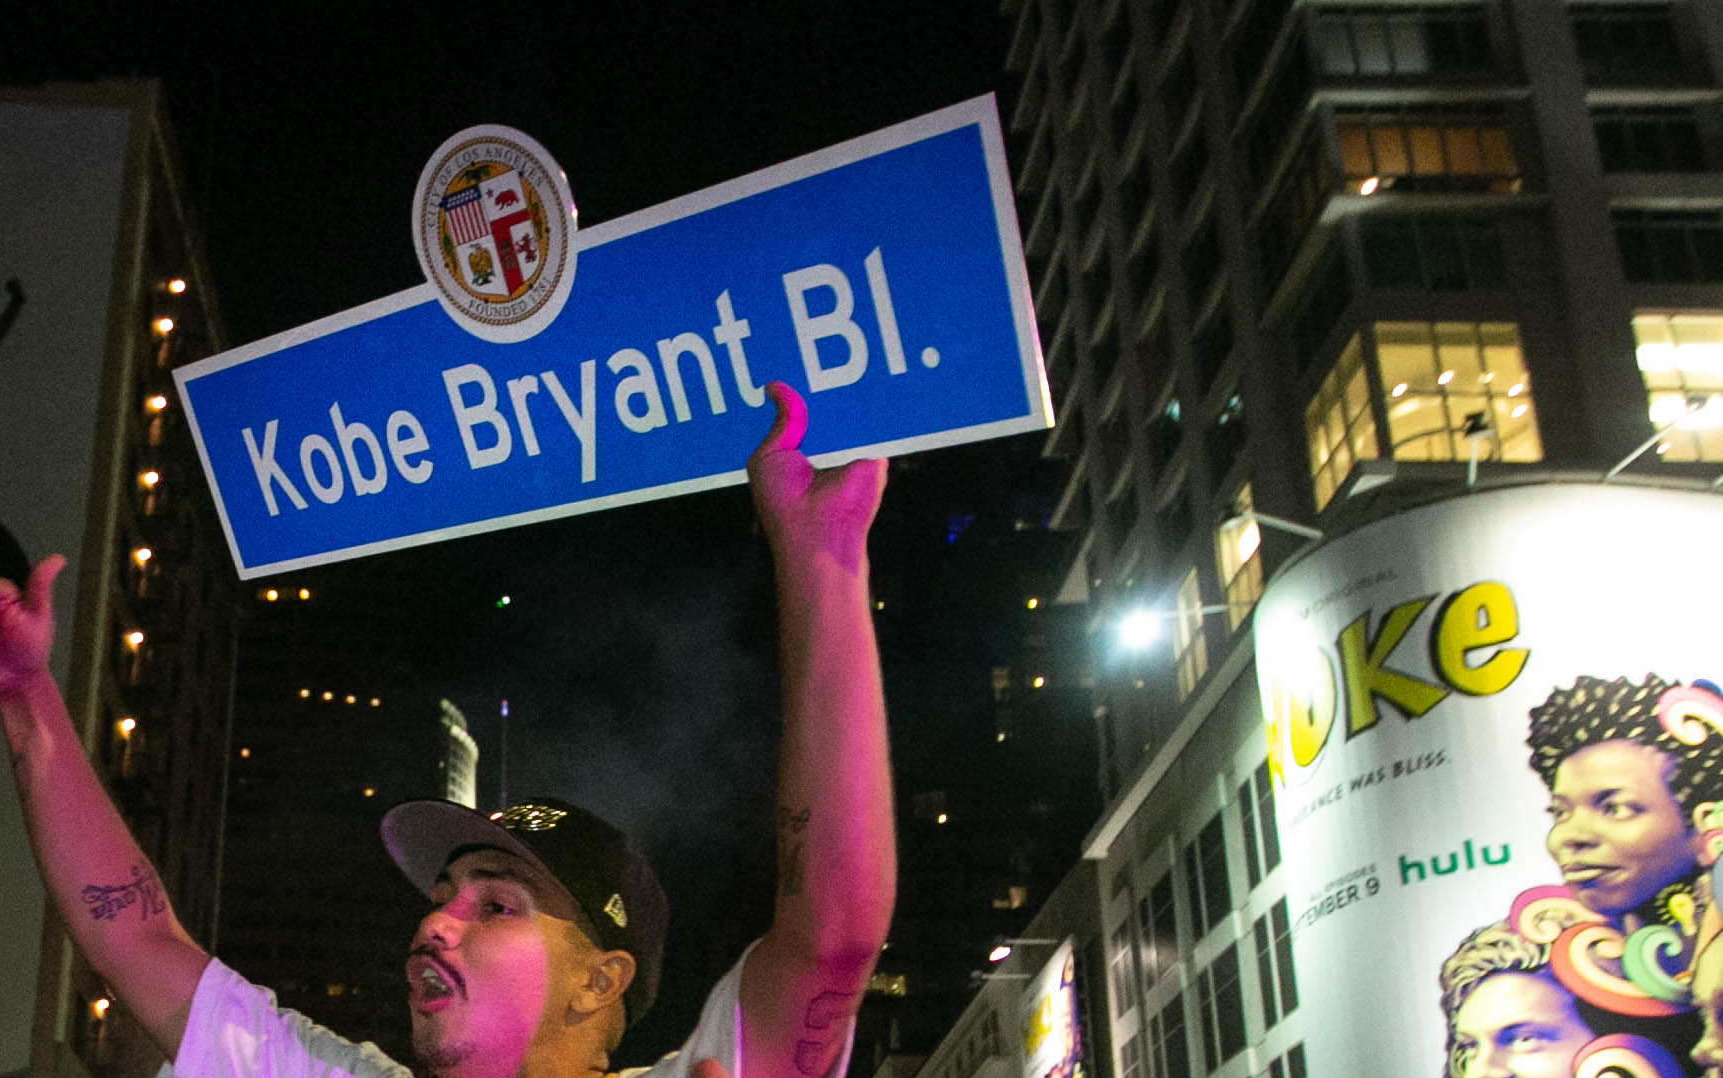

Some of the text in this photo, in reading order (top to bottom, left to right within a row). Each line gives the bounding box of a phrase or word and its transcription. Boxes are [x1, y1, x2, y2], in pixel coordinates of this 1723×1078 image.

[427, 146, 548, 228] CITY OF LOS ANGELES
[468, 299, 528, 319] FOUNDED
[242, 246, 941, 517] Kobe Bryant Bl.
[1349, 765, 1387, 794] WAS
[1398, 839, 1513, 886] hulu
[1365, 876, 1380, 897] 9
